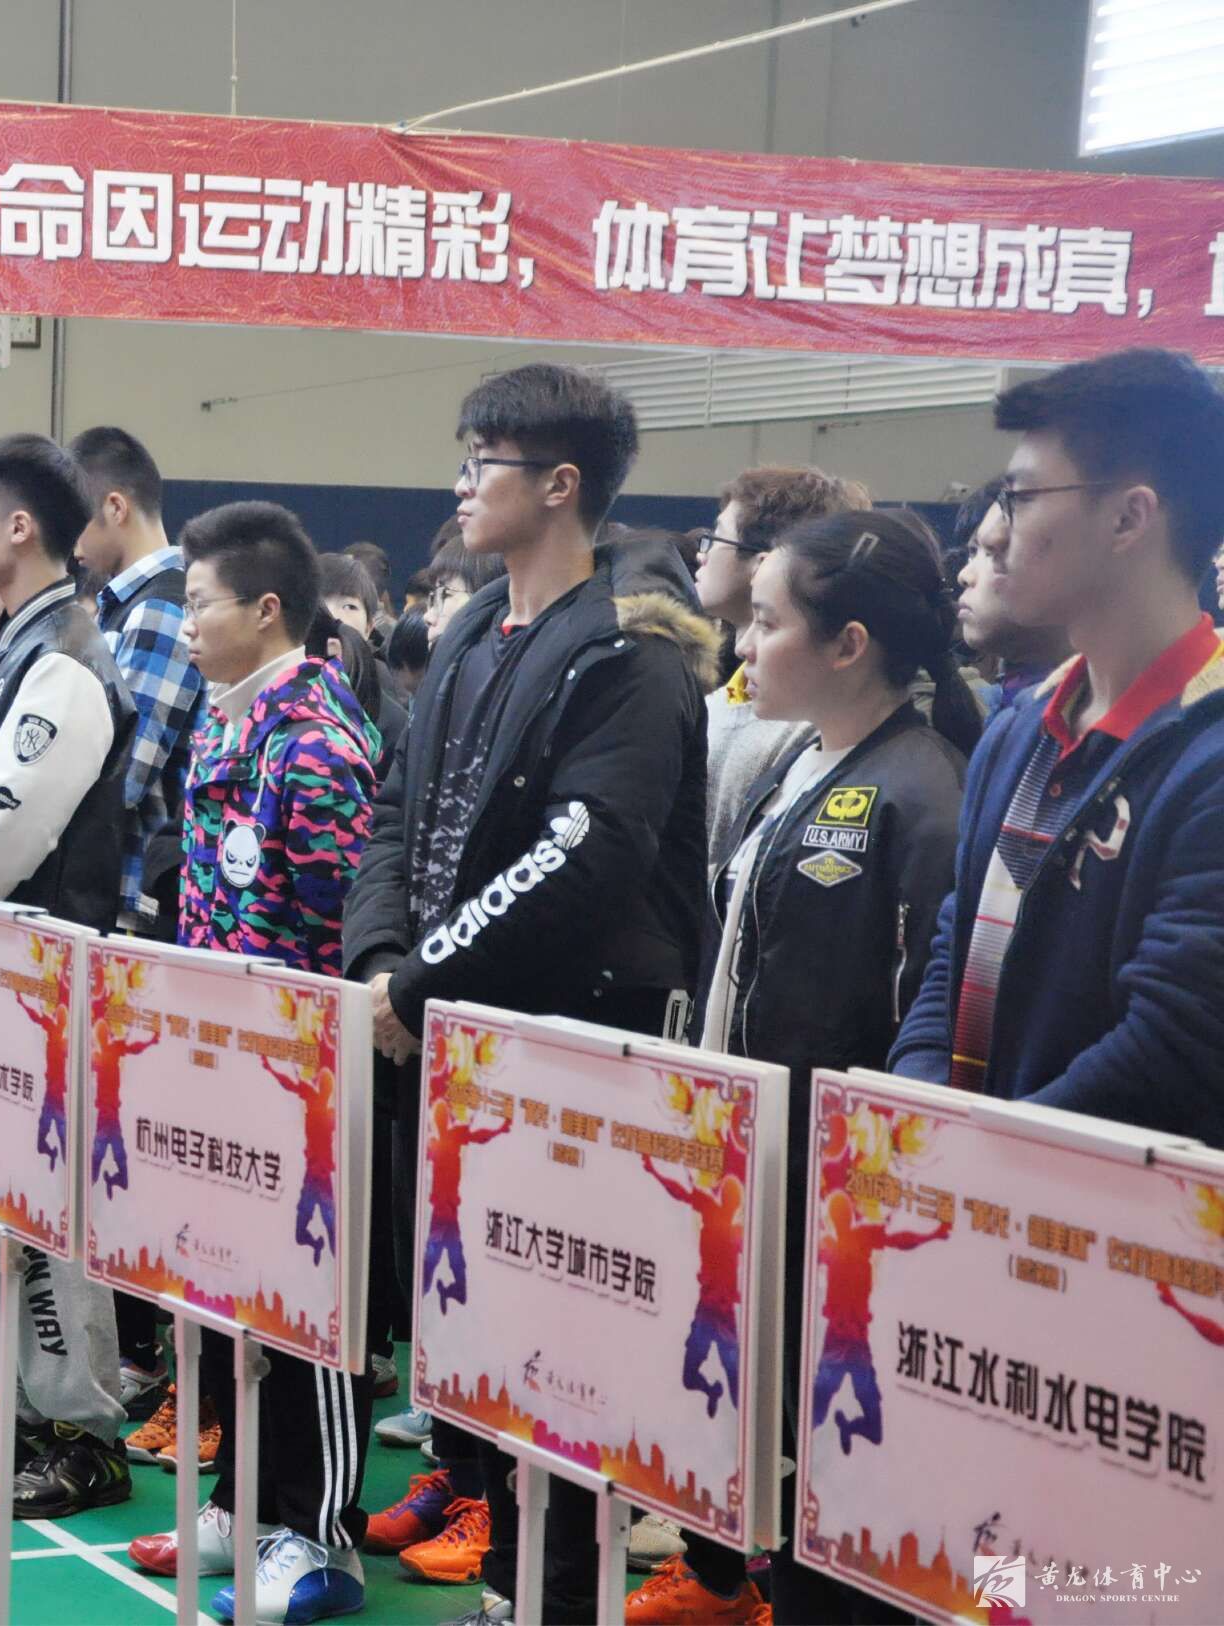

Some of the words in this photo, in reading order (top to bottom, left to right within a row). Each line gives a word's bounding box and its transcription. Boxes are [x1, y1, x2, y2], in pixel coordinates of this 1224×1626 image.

[592, 200, 1153, 319] 体育让梦想成真，
[421, 840, 566, 964] adidas
[136, 1117, 281, 1191] 杭州电子科技大学
[485, 1209, 656, 1303] 浙江大学城市学院
[28, 1289, 68, 1356] WAY
[896, 1321, 1207, 1483] 浙江水利水电学院
